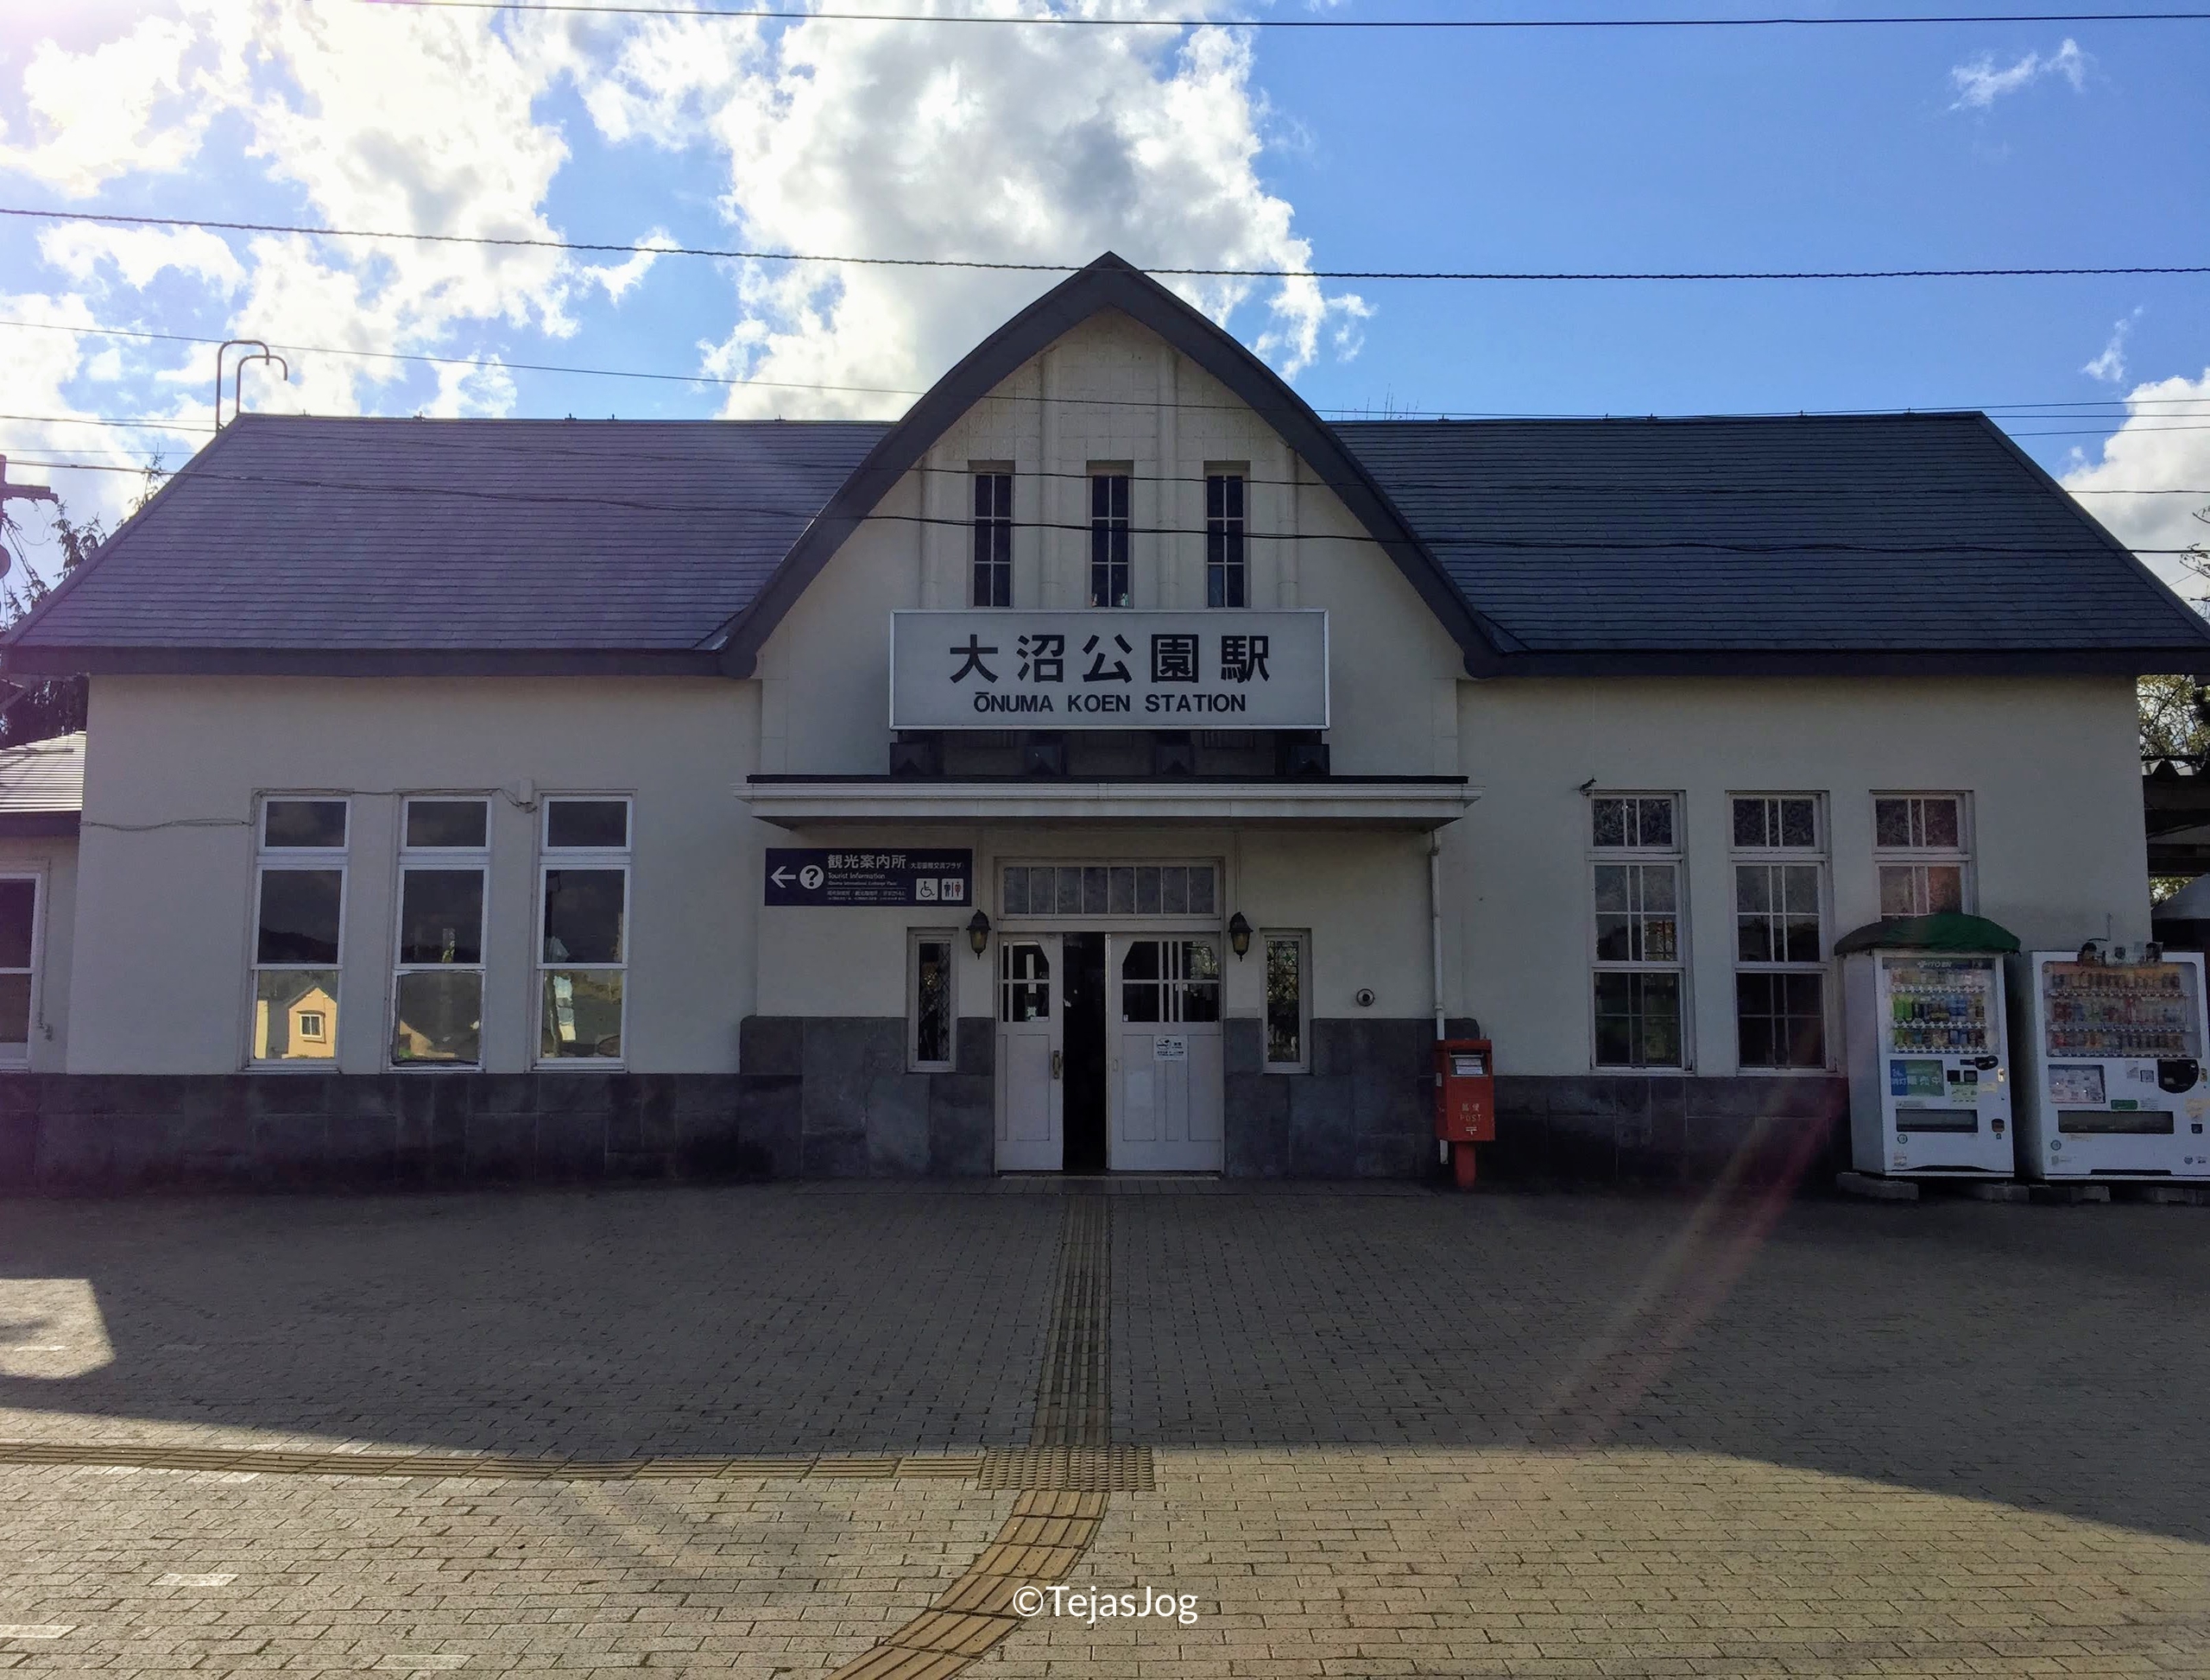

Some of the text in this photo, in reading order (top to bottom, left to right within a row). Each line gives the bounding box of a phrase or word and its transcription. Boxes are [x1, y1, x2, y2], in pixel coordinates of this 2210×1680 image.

[950, 634, 1270, 684] 大沼公園駅
[974, 692, 1246, 713] ŌNUMA KOEN STATION
[827, 854, 906, 869] 観光案内所
[1460, 1114, 1481, 1122] POST
